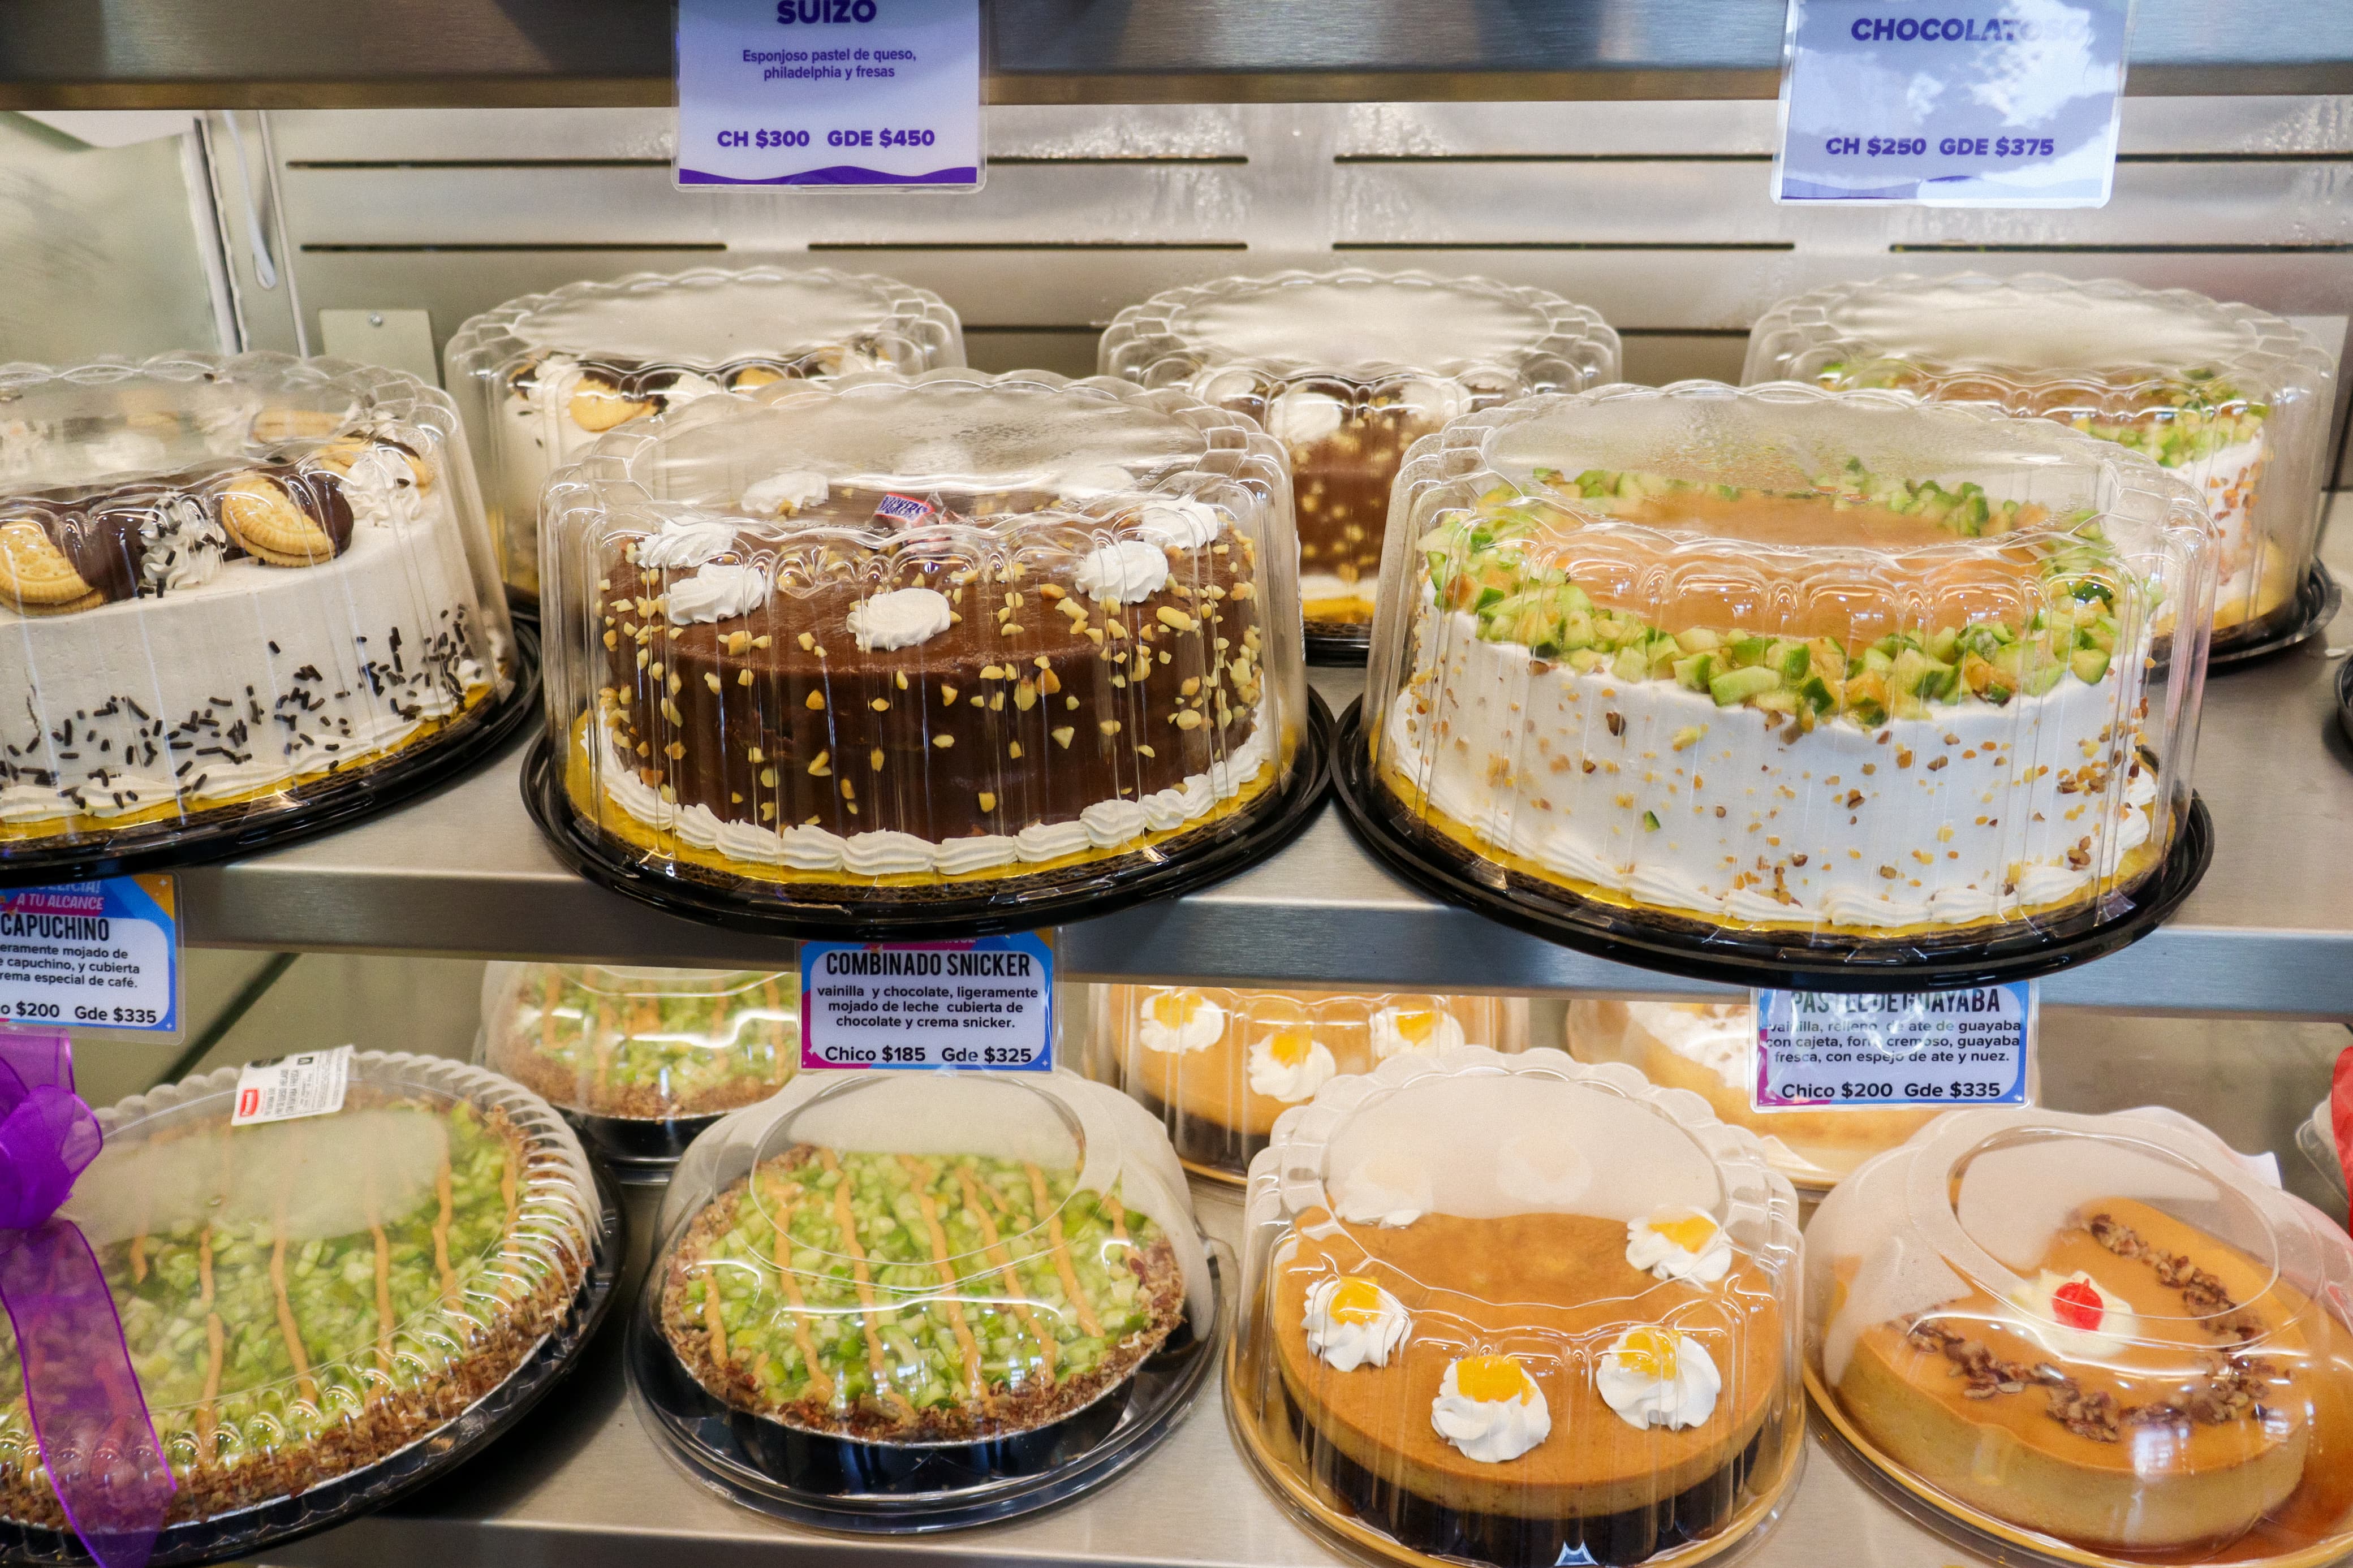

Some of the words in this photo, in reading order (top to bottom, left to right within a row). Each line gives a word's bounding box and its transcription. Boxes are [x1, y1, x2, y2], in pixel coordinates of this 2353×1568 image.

[777, 0, 877, 24] SUIZO
[743, 49, 808, 63] Esponjoso
[812, 47, 850, 63] pastel
[854, 48, 870, 61] de
[874, 49, 917, 62] queso,
[764, 65, 842, 81] philadelphia
[845, 68, 852, 80] y
[856, 64, 895, 78] fresas
[717, 131, 749, 147] CH
[755, 129, 810, 149] $300
[827, 130, 873, 147] GDE
[880, 128, 935, 148] $450
[1826, 139, 1860, 155] CH
[1867, 136, 1927, 158] $250
[1940, 138, 1988, 156] GDE
[1995, 136, 2054, 158] $375
[16, 893, 24, 906] A
[29, 893, 45, 907] TU
[48, 895, 105, 910] ALCANCE
[1, 913, 110, 941] CAPUCHINO
[63, 948, 109, 959] mojado
[113, 949, 128, 960] de
[7, 958, 75, 971] capuchino,
[78, 963, 85, 973] y
[89, 962, 140, 974] cubierta
[826, 952, 942, 976] COMBINADO
[947, 953, 1031, 977] SNICKER
[35, 974, 85, 986] especial
[88, 977, 105, 986] de
[107, 977, 138, 988] café.
[817, 986, 864, 997] vainilla
[872, 990, 880, 1000] y
[884, 987, 954, 1000] chocolate,
[957, 988, 1038, 1001] ligeramente
[16, 1000, 60, 1018] $200
[74, 1006, 108, 1021] Gde
[113, 1007, 157, 1024] $335
[828, 1001, 878, 1014] mojado
[882, 1002, 899, 1012] de
[903, 1001, 940, 1013] leche
[947, 1003, 1003, 1013] cubierta
[1006, 1003, 1023, 1013] de
[836, 1016, 902, 1027] chocolate
[906, 1020, 913, 1030] y
[917, 1020, 959, 1028] crema
[963, 1017, 1015, 1028] snicker.
[1908, 1021, 1932, 1031] ate
[1936, 1020, 1954, 1031] de
[1958, 1020, 2021, 1034] guayaba
[1765, 1038, 1791, 1047] con
[1796, 1036, 1842, 1049] cajeta,
[1887, 1036, 1953, 1048] cremoso,
[1958, 1035, 2020, 1049] guayaba
[825, 1046, 877, 1061] Chico
[882, 1044, 926, 1063] $185
[942, 1048, 979, 1062] Gde
[984, 1046, 1032, 1064] $325
[1775, 1051, 1821, 1064] fresca,
[1856, 1051, 1904, 1064] espejo
[1909, 1051, 1927, 1062] de
[1931, 1051, 1954, 1062] ate
[1958, 1053, 1967, 1064] y
[1971, 1052, 2010, 1062] nuez.
[1782, 1083, 1835, 1098] Chico
[1841, 1082, 1893, 1099] $200
[1904, 1083, 1943, 1098] Gde
[1950, 1081, 2000, 1099] $335
